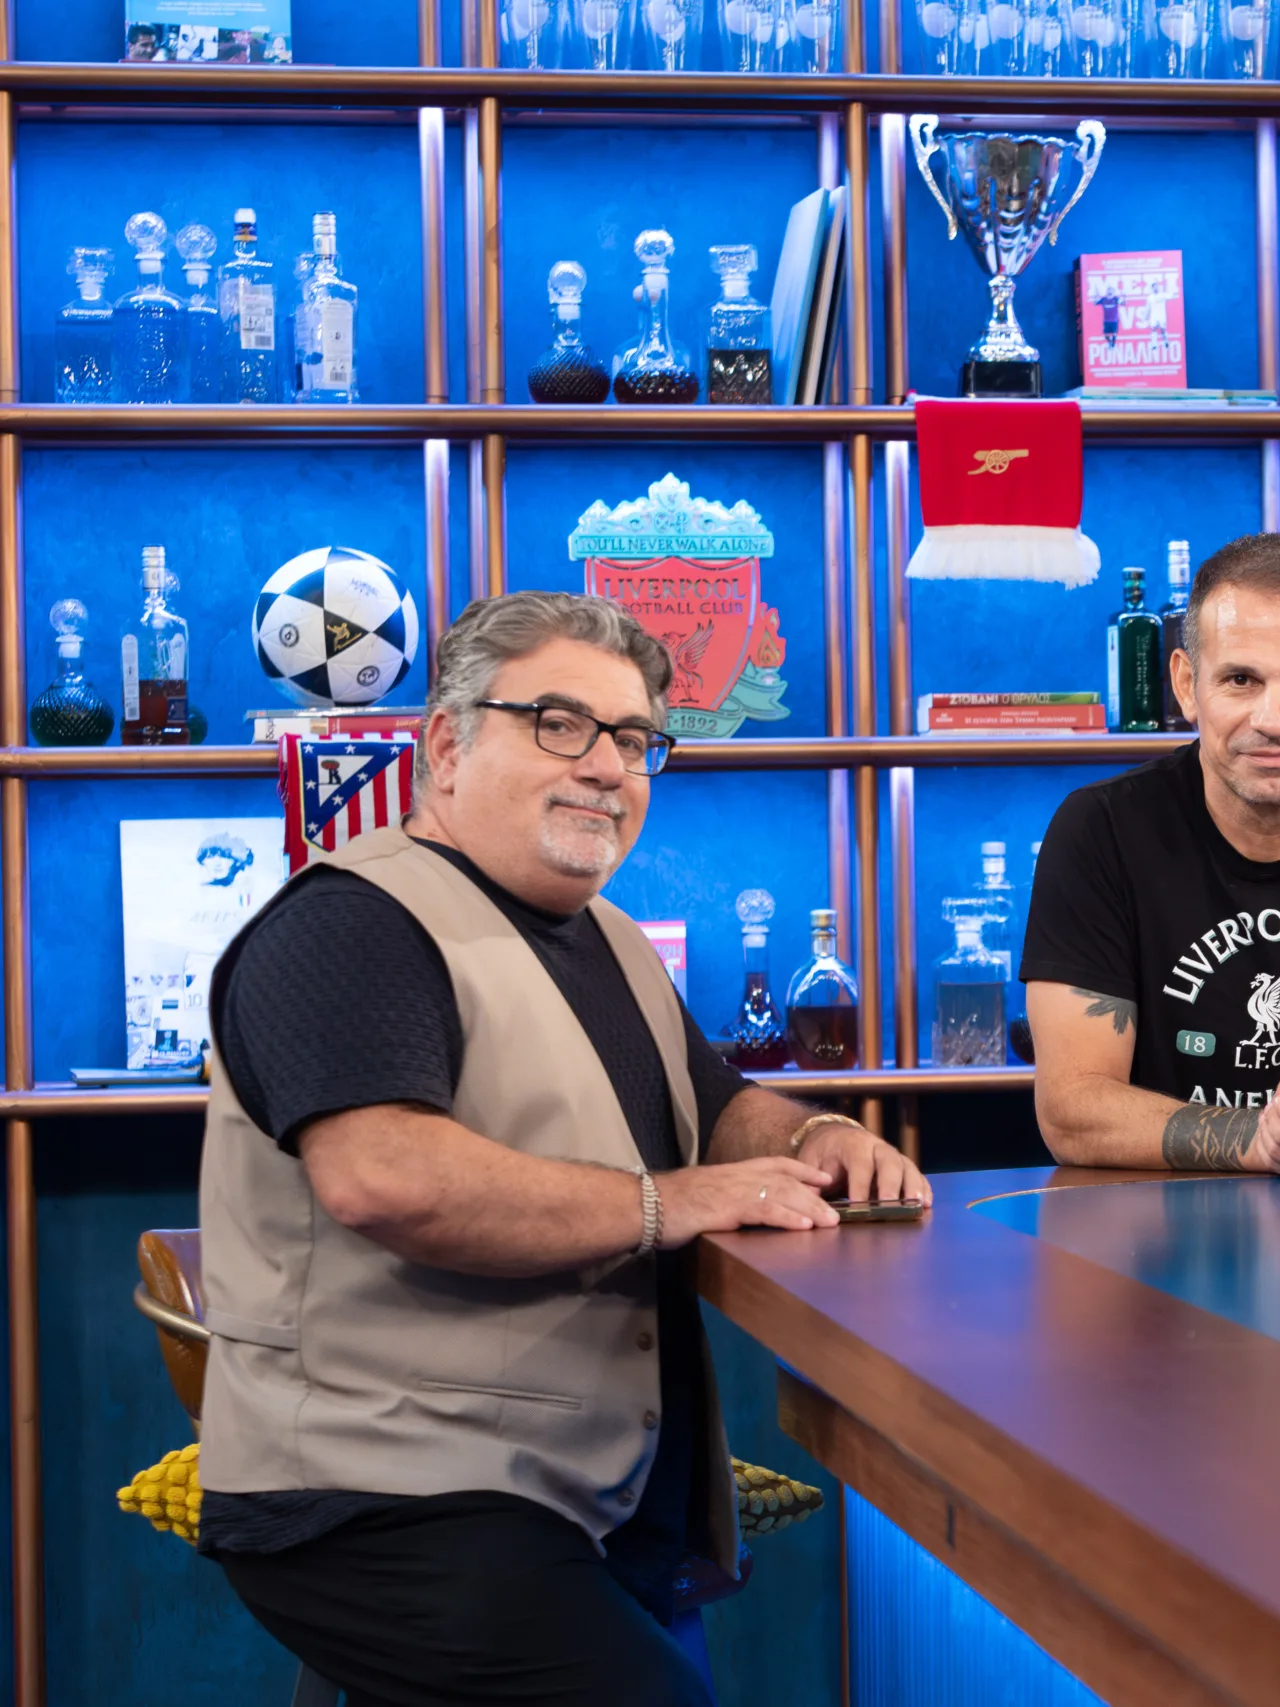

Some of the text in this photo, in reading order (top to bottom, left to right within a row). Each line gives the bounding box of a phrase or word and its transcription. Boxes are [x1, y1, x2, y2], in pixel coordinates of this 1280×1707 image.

[628, 537, 675, 551] NEVER
[676, 537, 718, 551] WALK
[720, 537, 767, 551] ALONE
[604, 578, 746, 599] LIVERPOOL
[699, 601, 744, 615] CLUB
[1183, 1034, 1207, 1054] 18
